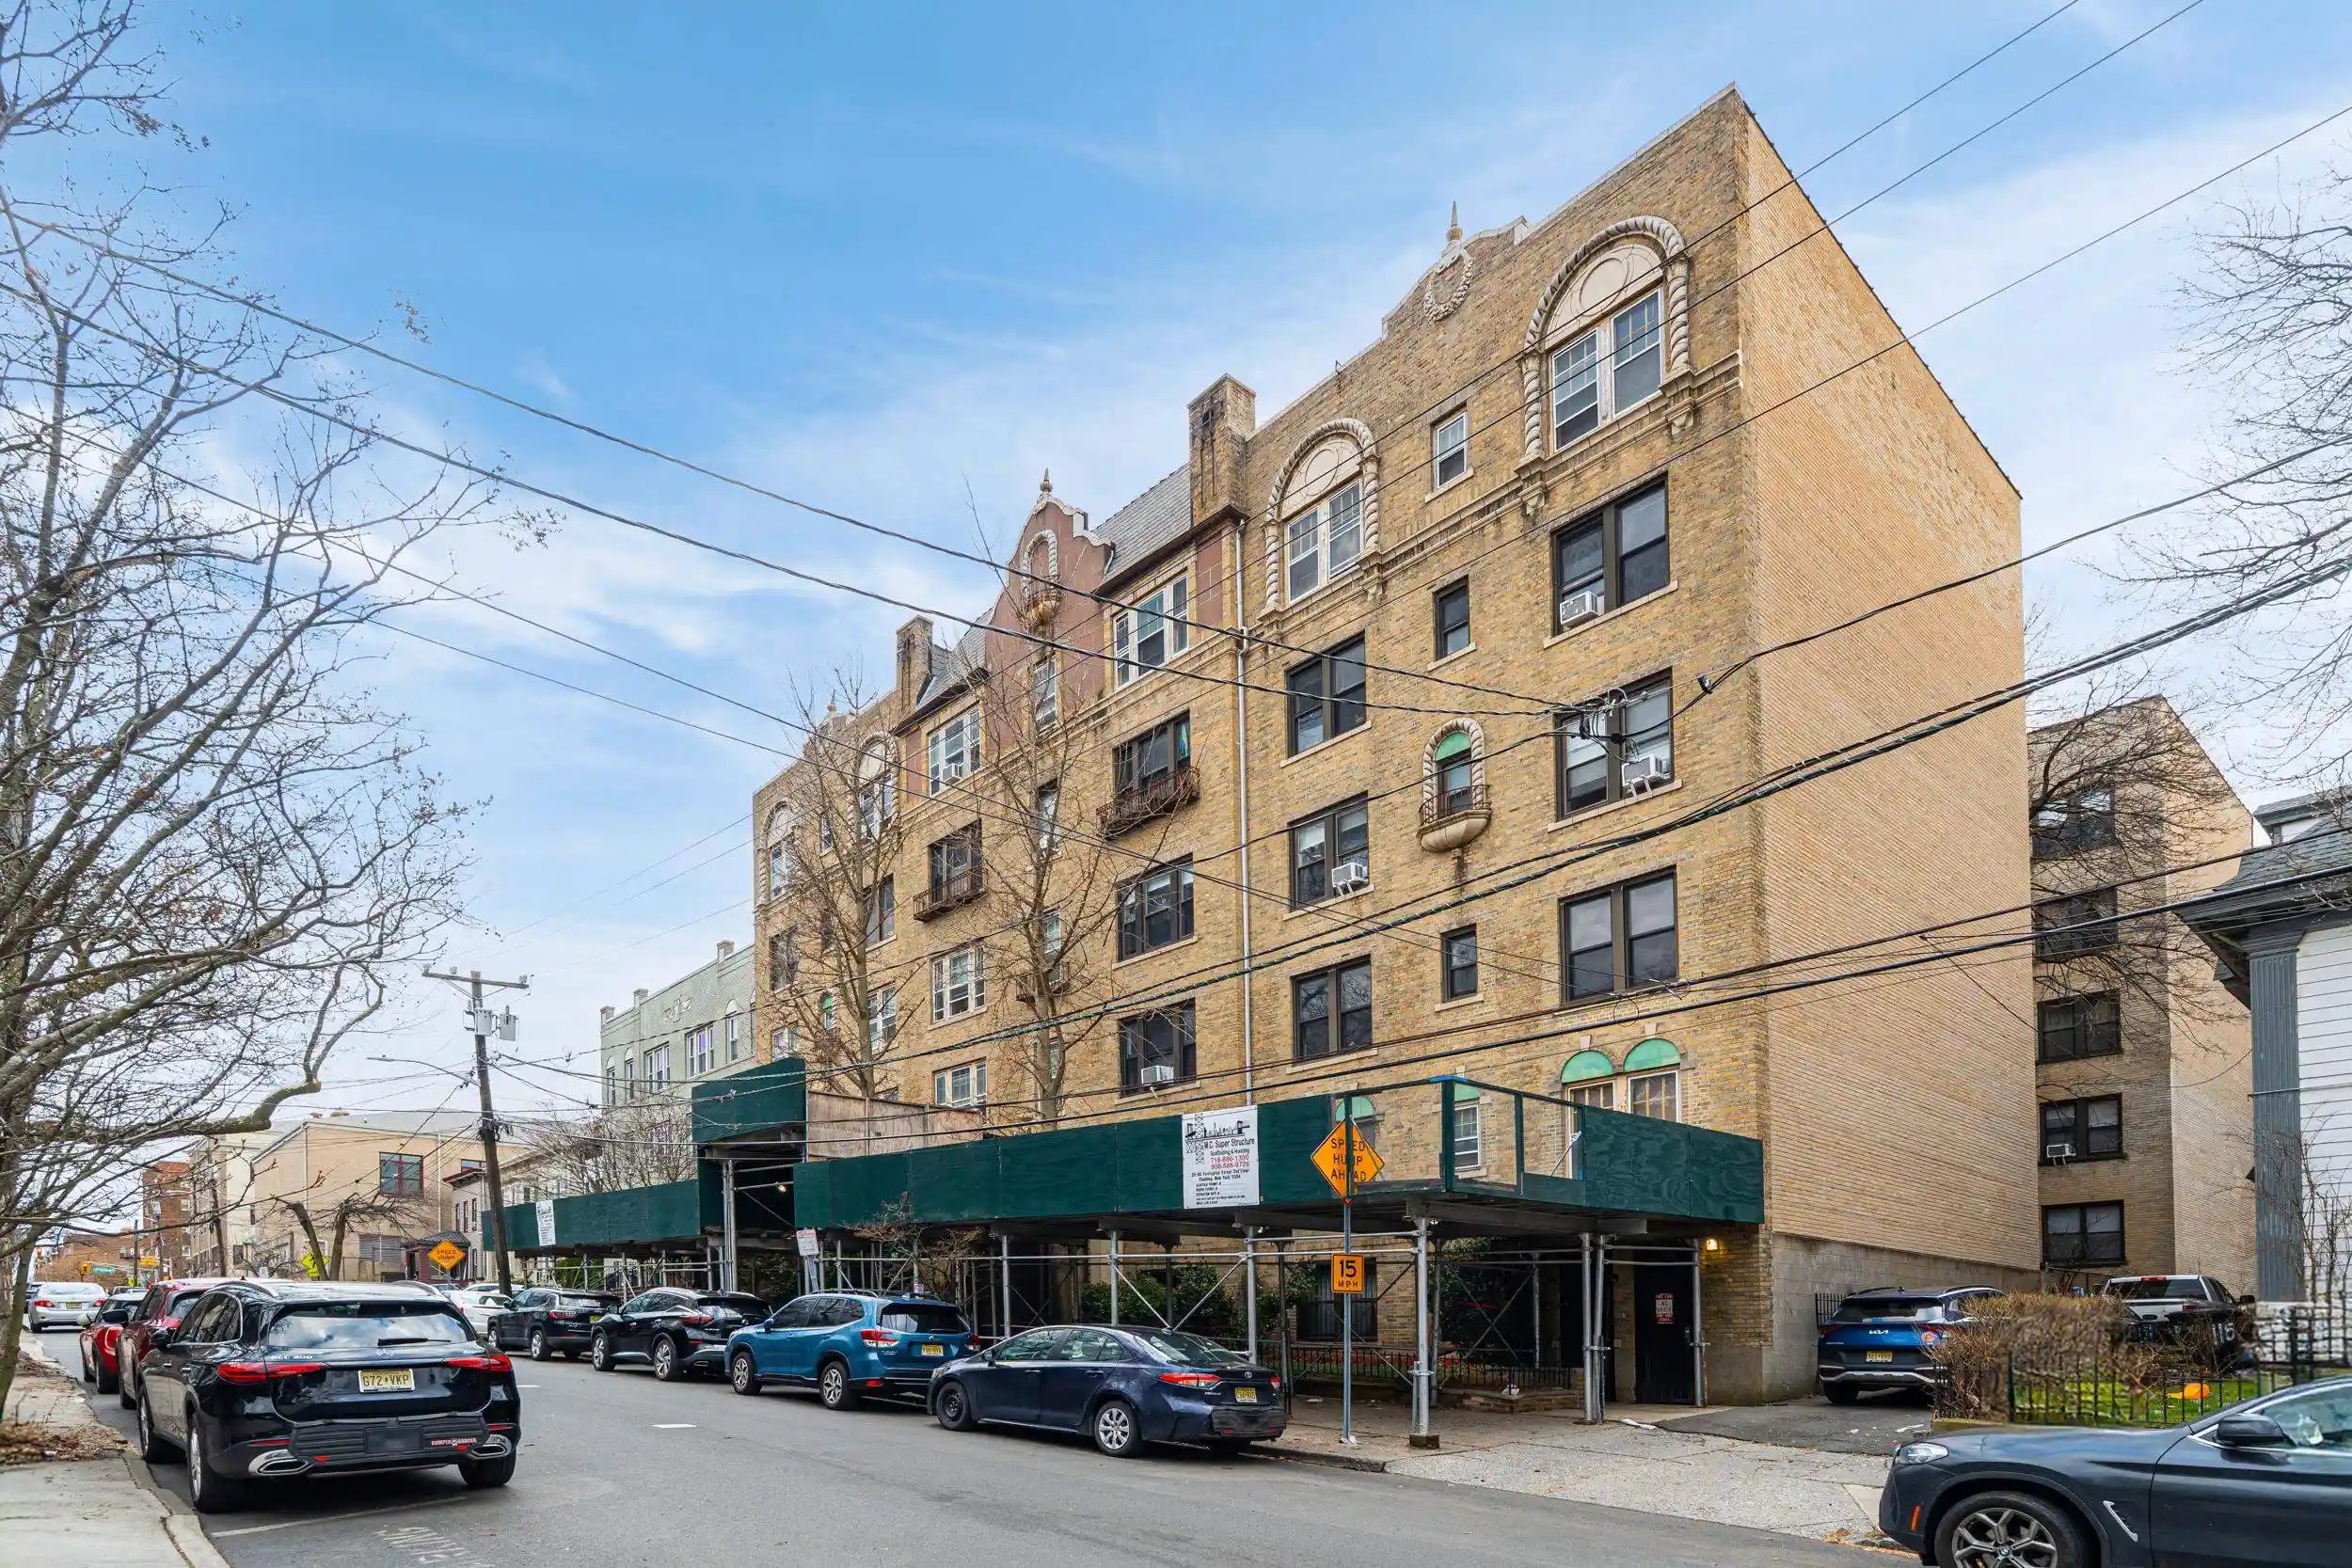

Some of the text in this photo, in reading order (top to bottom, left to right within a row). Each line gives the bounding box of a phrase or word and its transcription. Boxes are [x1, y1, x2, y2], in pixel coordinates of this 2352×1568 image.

[1215, 1140, 1231, 1148] Super
[1232, 1138, 1255, 1147] Structure
[1331, 1138, 1365, 1151] SPED
[1333, 1153, 1363, 1165] HUP
[1331, 1168, 1366, 1181] AHAD
[1340, 1259, 1357, 1277] 15
